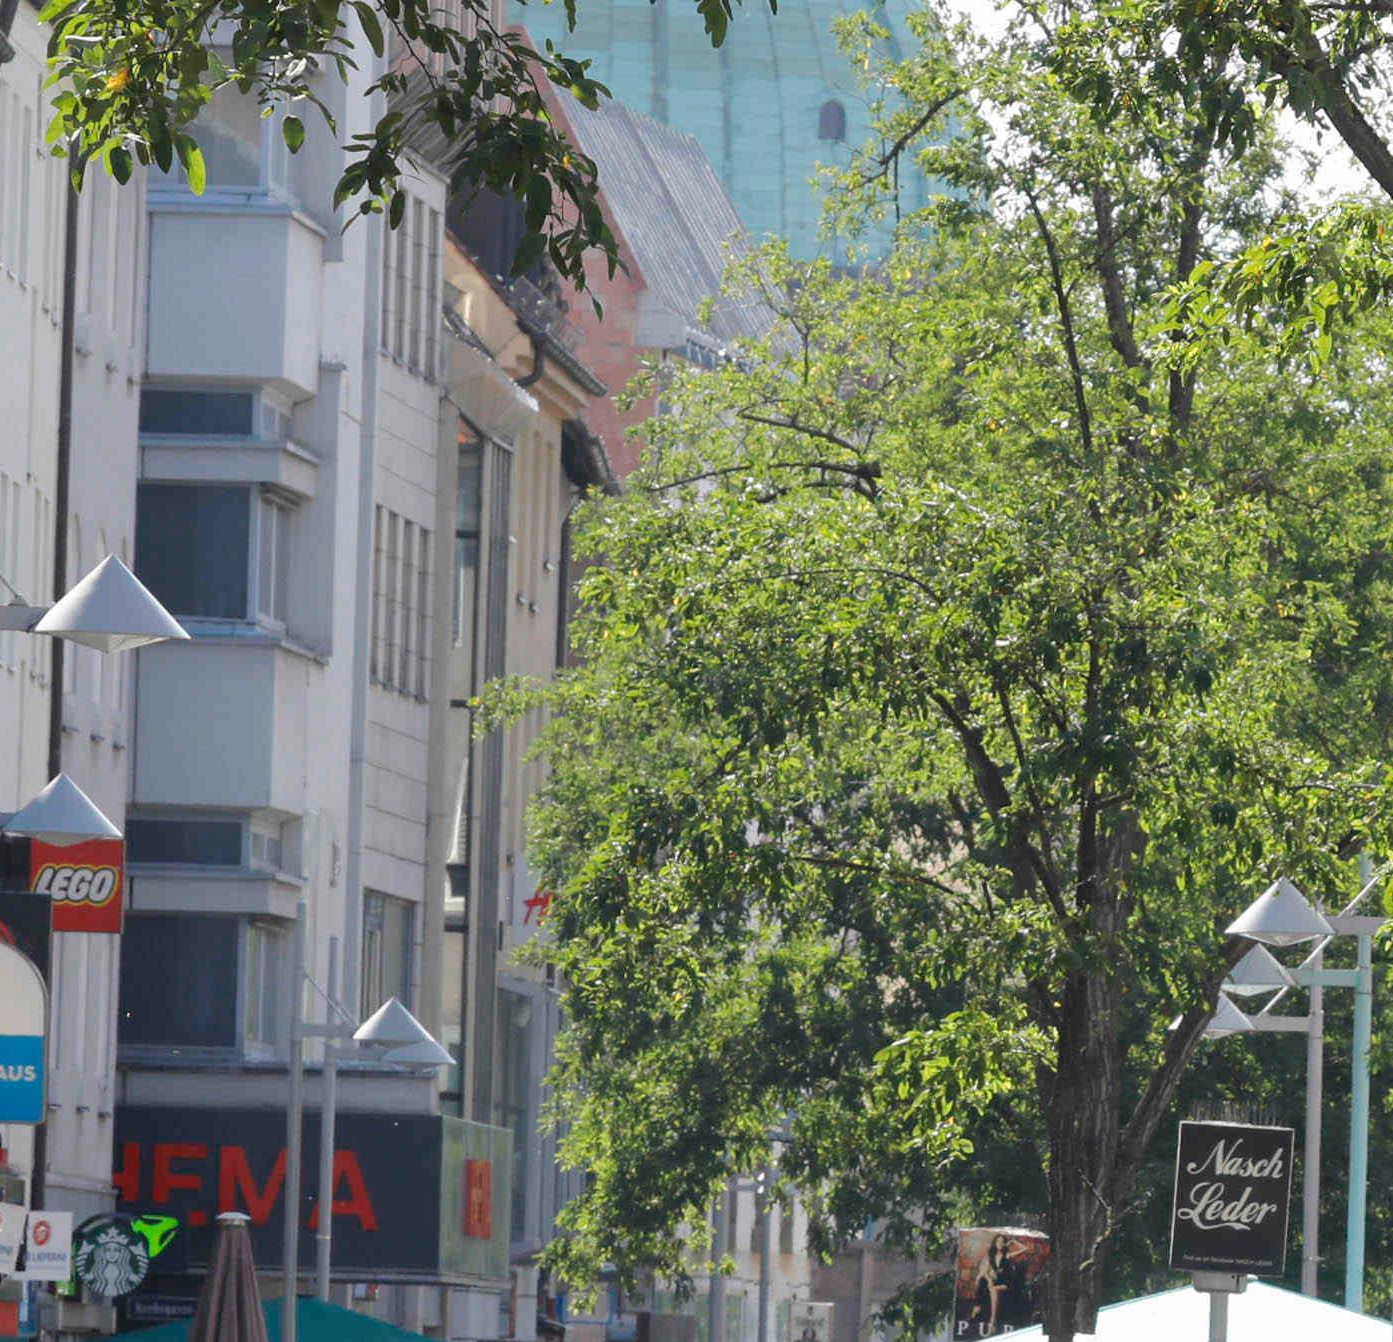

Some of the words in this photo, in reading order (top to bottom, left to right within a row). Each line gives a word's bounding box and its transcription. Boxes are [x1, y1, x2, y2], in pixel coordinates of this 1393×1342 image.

[33, 864, 118, 905] LEGO
[1187, 1138, 1283, 1178] Nasch
[1178, 1182, 1277, 1230] Leder
